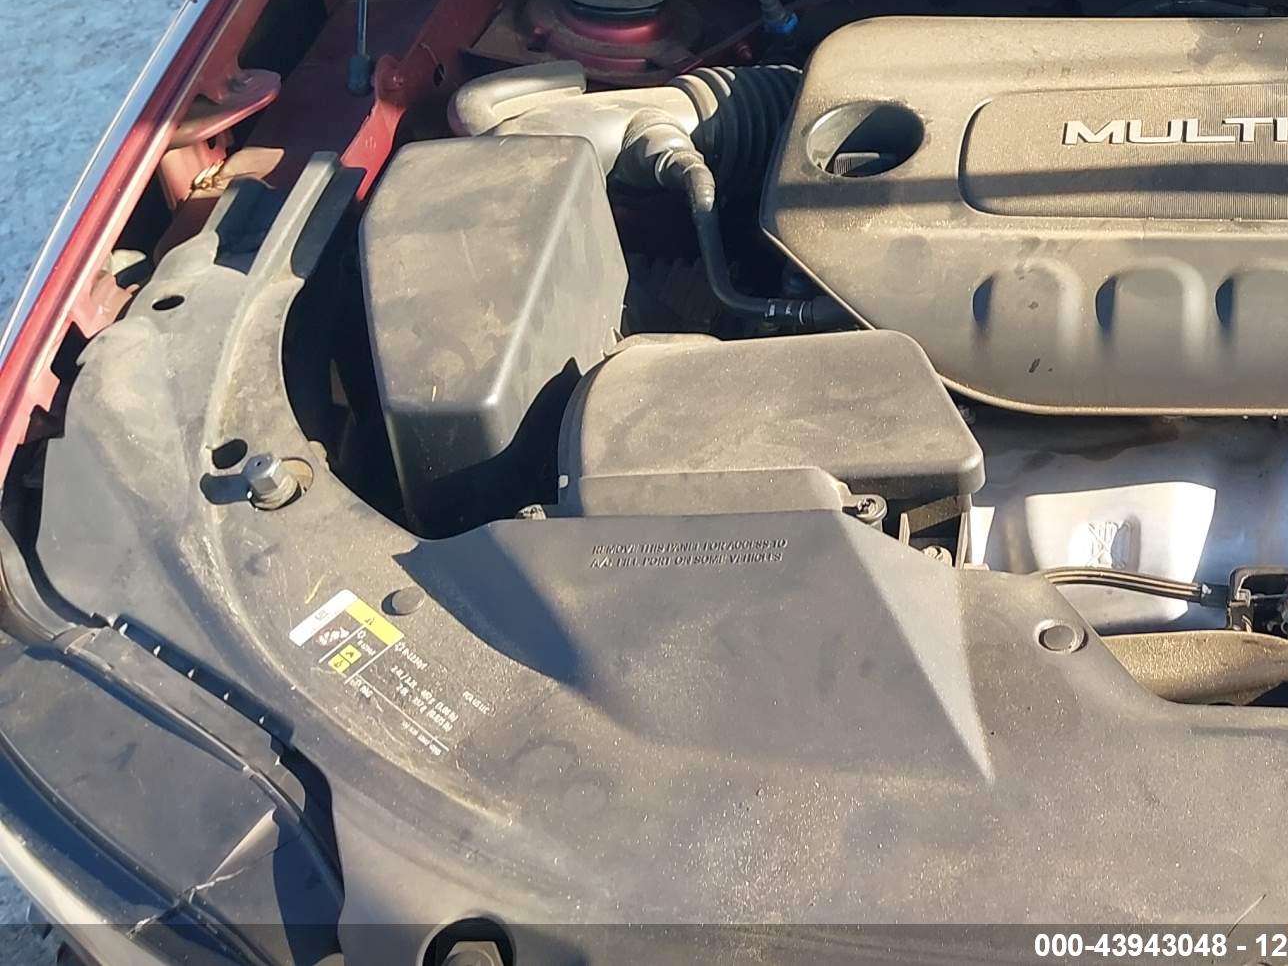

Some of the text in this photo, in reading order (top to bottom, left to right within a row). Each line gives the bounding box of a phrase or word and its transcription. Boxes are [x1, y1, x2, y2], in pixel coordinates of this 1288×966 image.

[592, 538, 788, 554] REMOVE THIS PANEL FOR ACCESS TO
[643, 555, 672, 566] PORT
[674, 554, 693, 565] ON
[729, 552, 784, 563] VEHICLES
